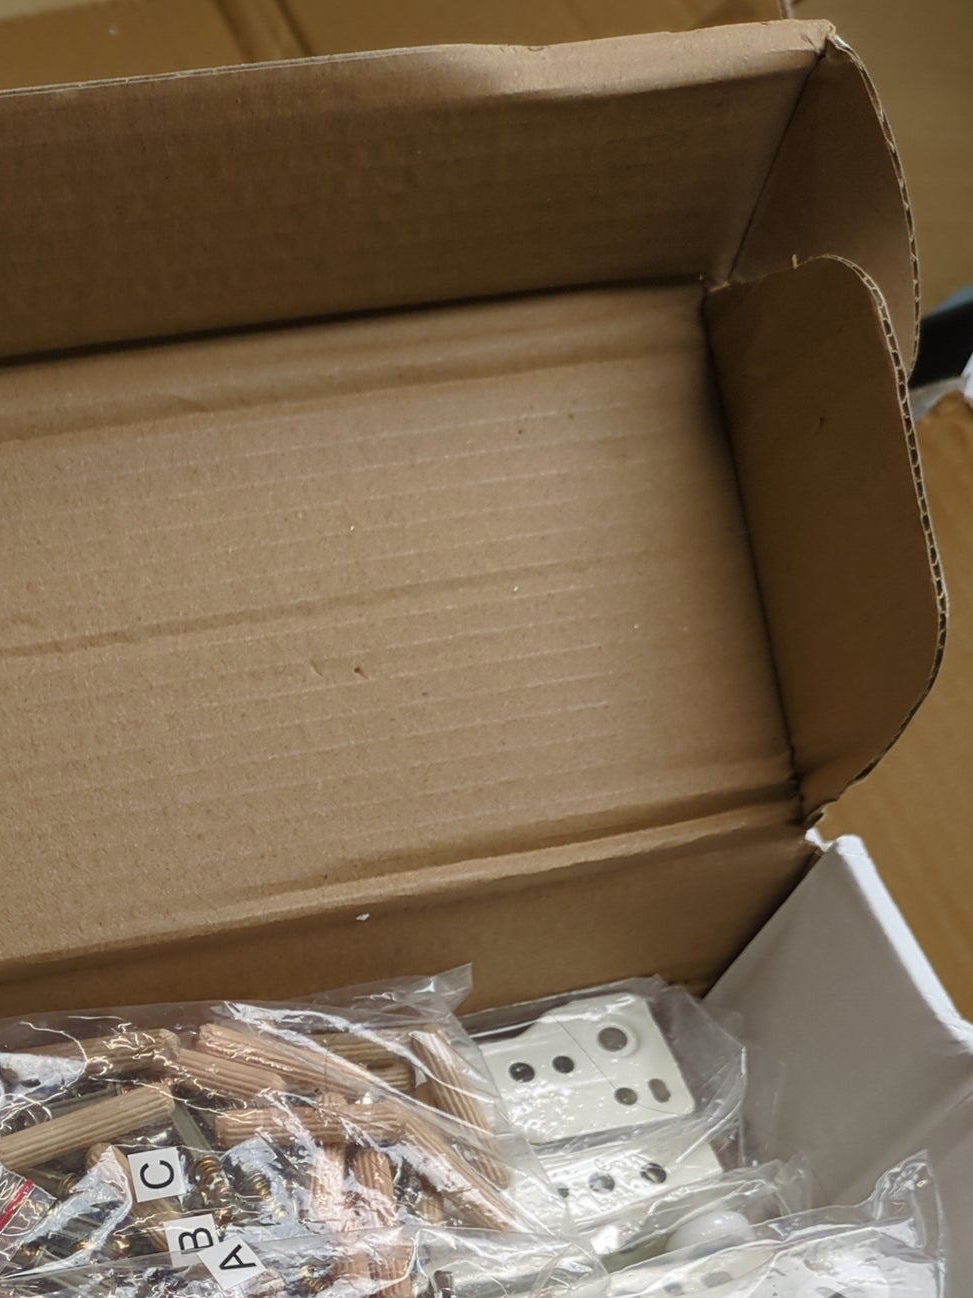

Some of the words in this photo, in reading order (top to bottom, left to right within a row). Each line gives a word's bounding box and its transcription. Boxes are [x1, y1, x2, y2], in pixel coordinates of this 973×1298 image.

[139, 1160, 174, 1190] C
[178, 1227, 214, 1255] B
[218, 1244, 256, 1270] A
